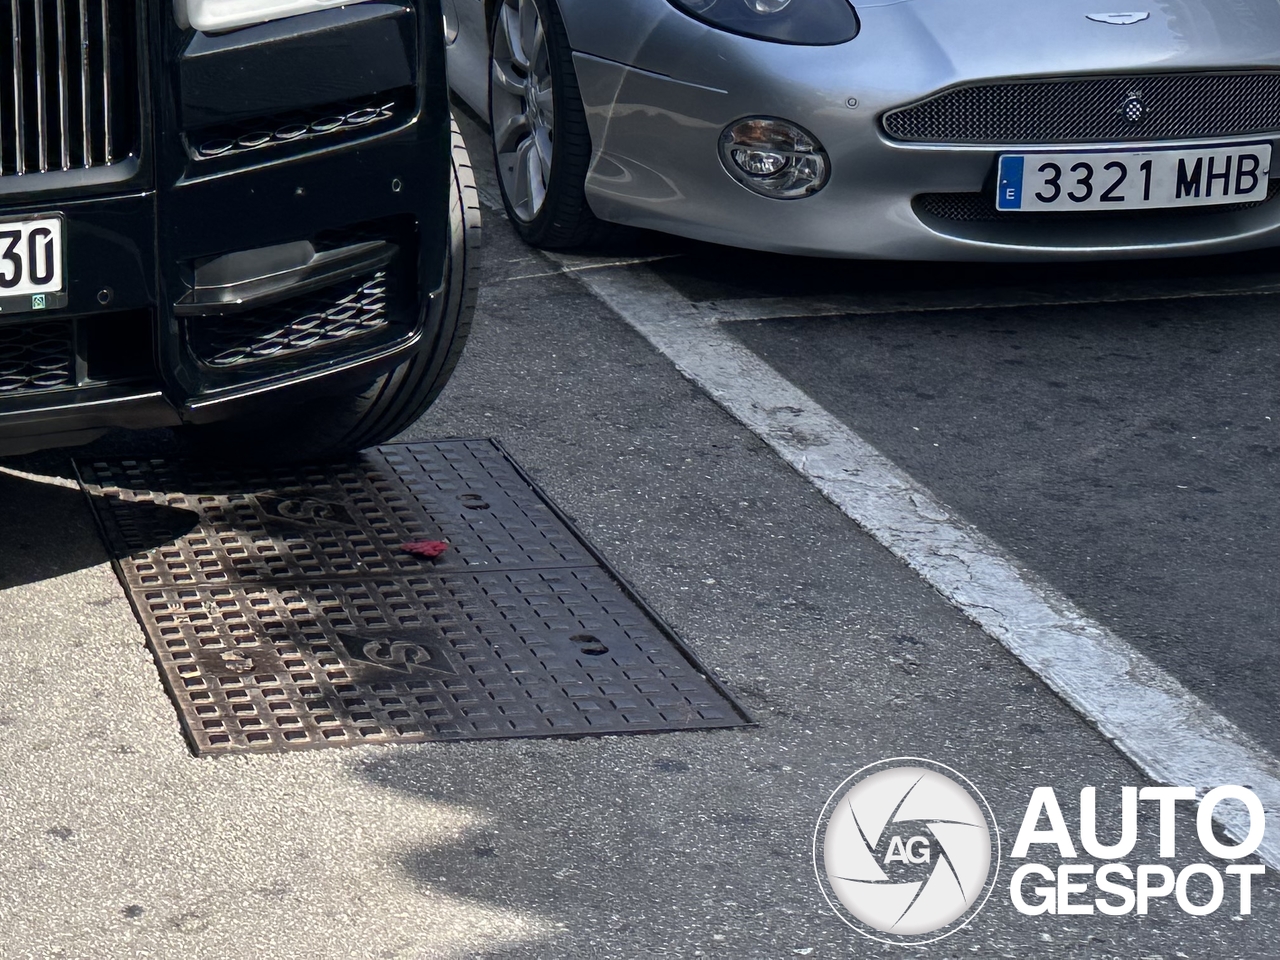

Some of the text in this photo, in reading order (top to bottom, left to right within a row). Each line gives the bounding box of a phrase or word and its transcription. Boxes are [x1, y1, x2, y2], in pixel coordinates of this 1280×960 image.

[1005, 187, 1016, 200] E
[1034, 154, 1261, 204] 3321 MHB
